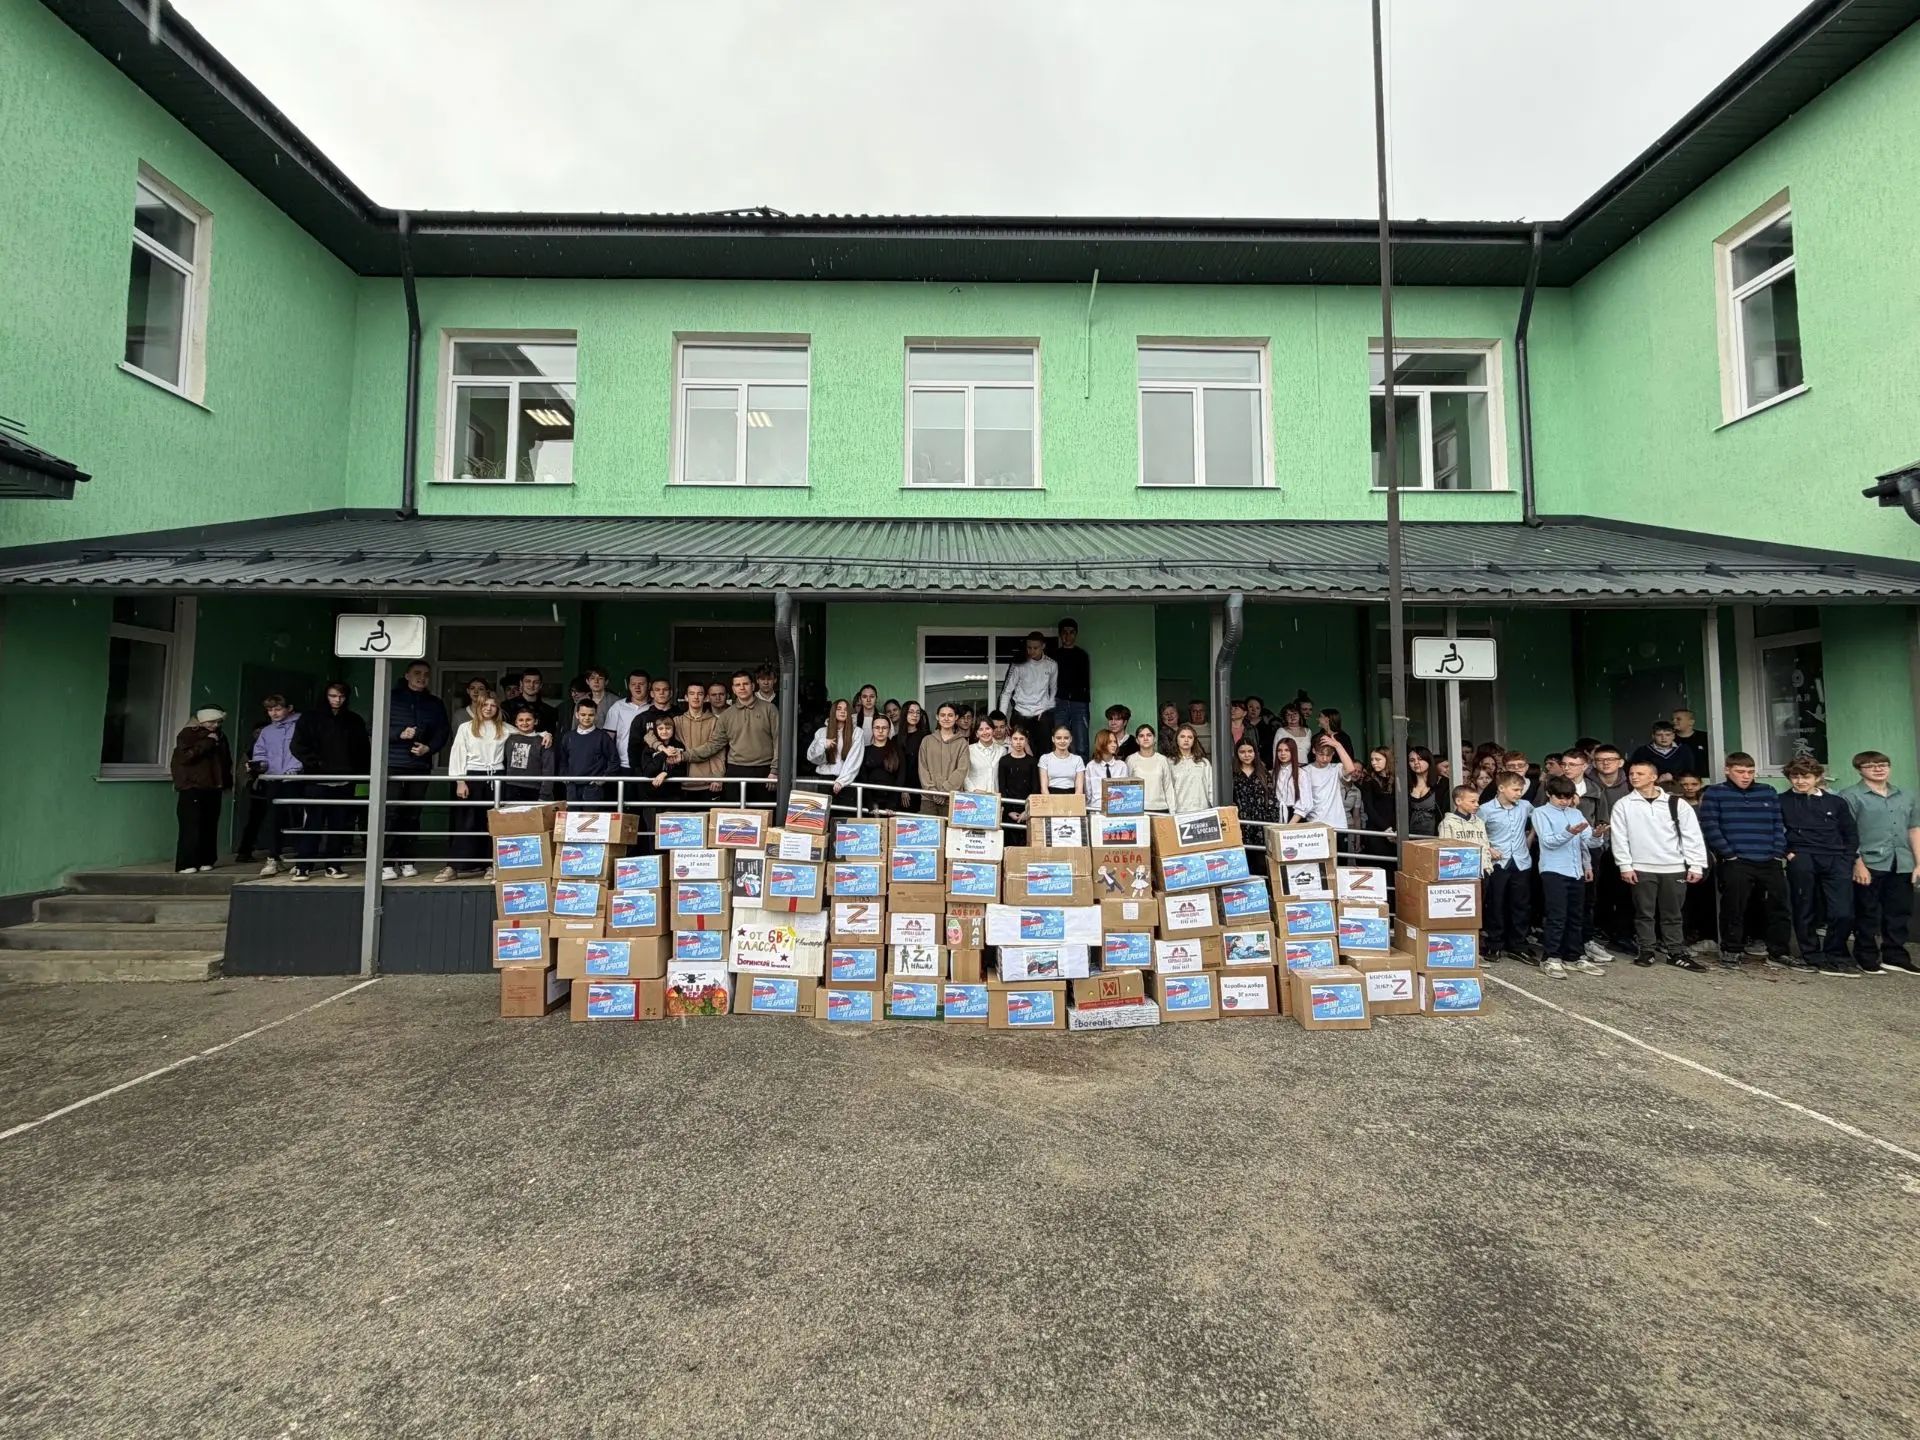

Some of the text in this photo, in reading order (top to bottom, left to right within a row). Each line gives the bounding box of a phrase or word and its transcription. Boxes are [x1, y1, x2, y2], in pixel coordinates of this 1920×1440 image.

[576, 813, 600, 832] Z
[1180, 824, 1194, 839] Z
[1102, 854, 1142, 863] ДОБРА
[1349, 871, 1374, 890] Z
[1455, 895, 1472, 911] Z
[847, 904, 868, 924] Z
[749, 932, 763, 940] ОТ
[768, 930, 783, 944] 6В
[738, 941, 778, 954] КЛАССА
[1392, 979, 1408, 995] Z
[1078, 1017, 1112, 1028] borealis
